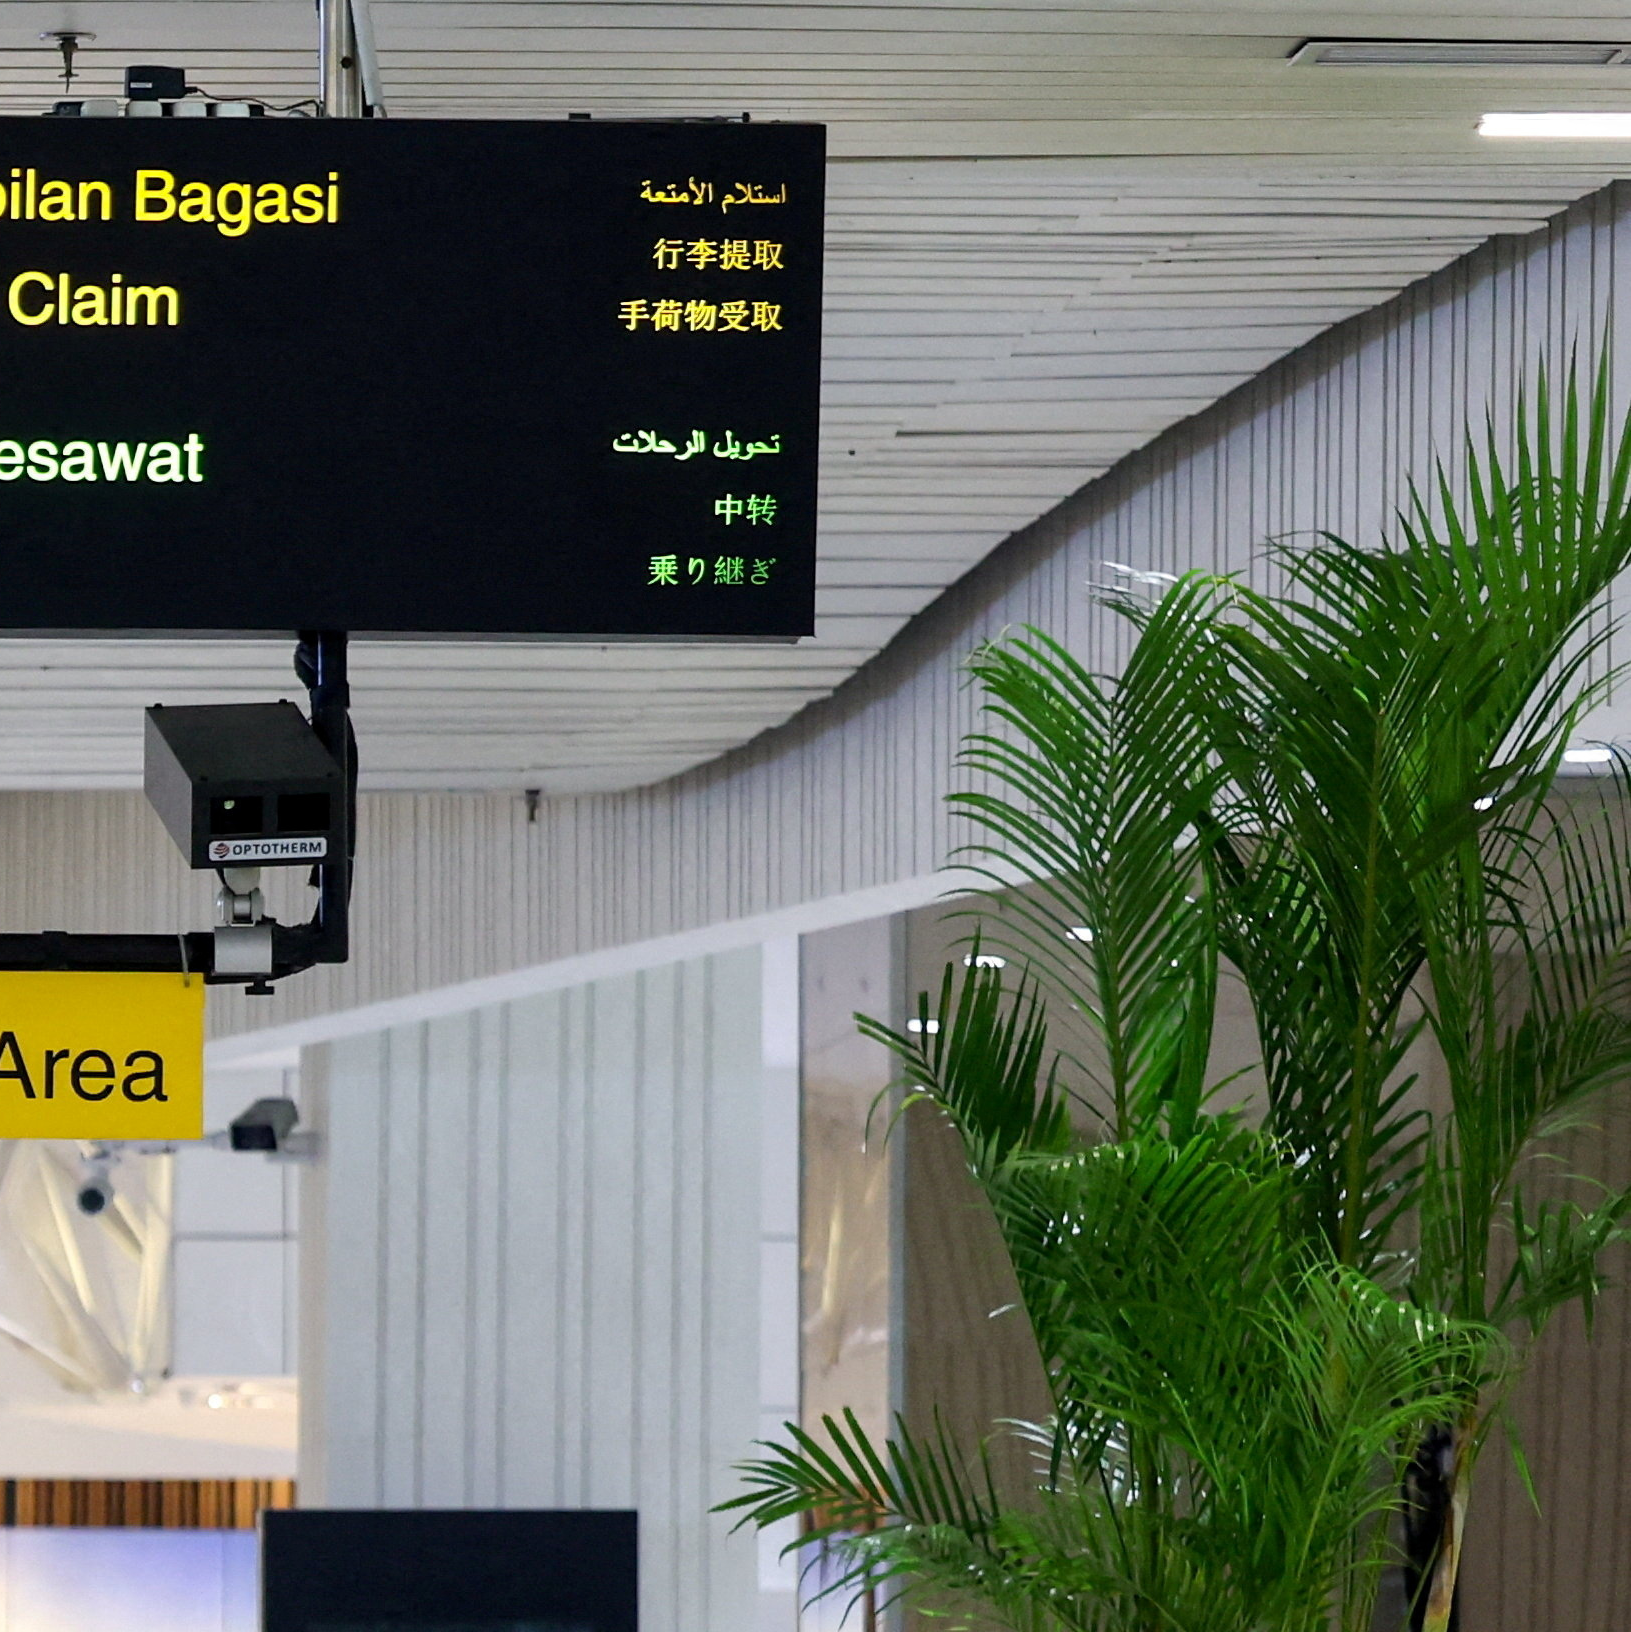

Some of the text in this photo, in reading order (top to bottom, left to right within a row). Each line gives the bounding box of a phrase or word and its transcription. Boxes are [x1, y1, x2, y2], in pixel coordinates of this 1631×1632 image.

[135, 169, 339, 238] Bagasi
[639, 176, 786, 215] استلام الأمتعة
[652, 237, 784, 271] 行李提取
[8, 271, 179, 326] Claim
[617, 298, 783, 332] 手荷物受取
[612, 429, 780, 461] تحويل الرحلات
[714, 493, 778, 526] 中转
[647, 553, 776, 586] 乗り継ぎ
[231, 839, 325, 858] OPTOTHERM
